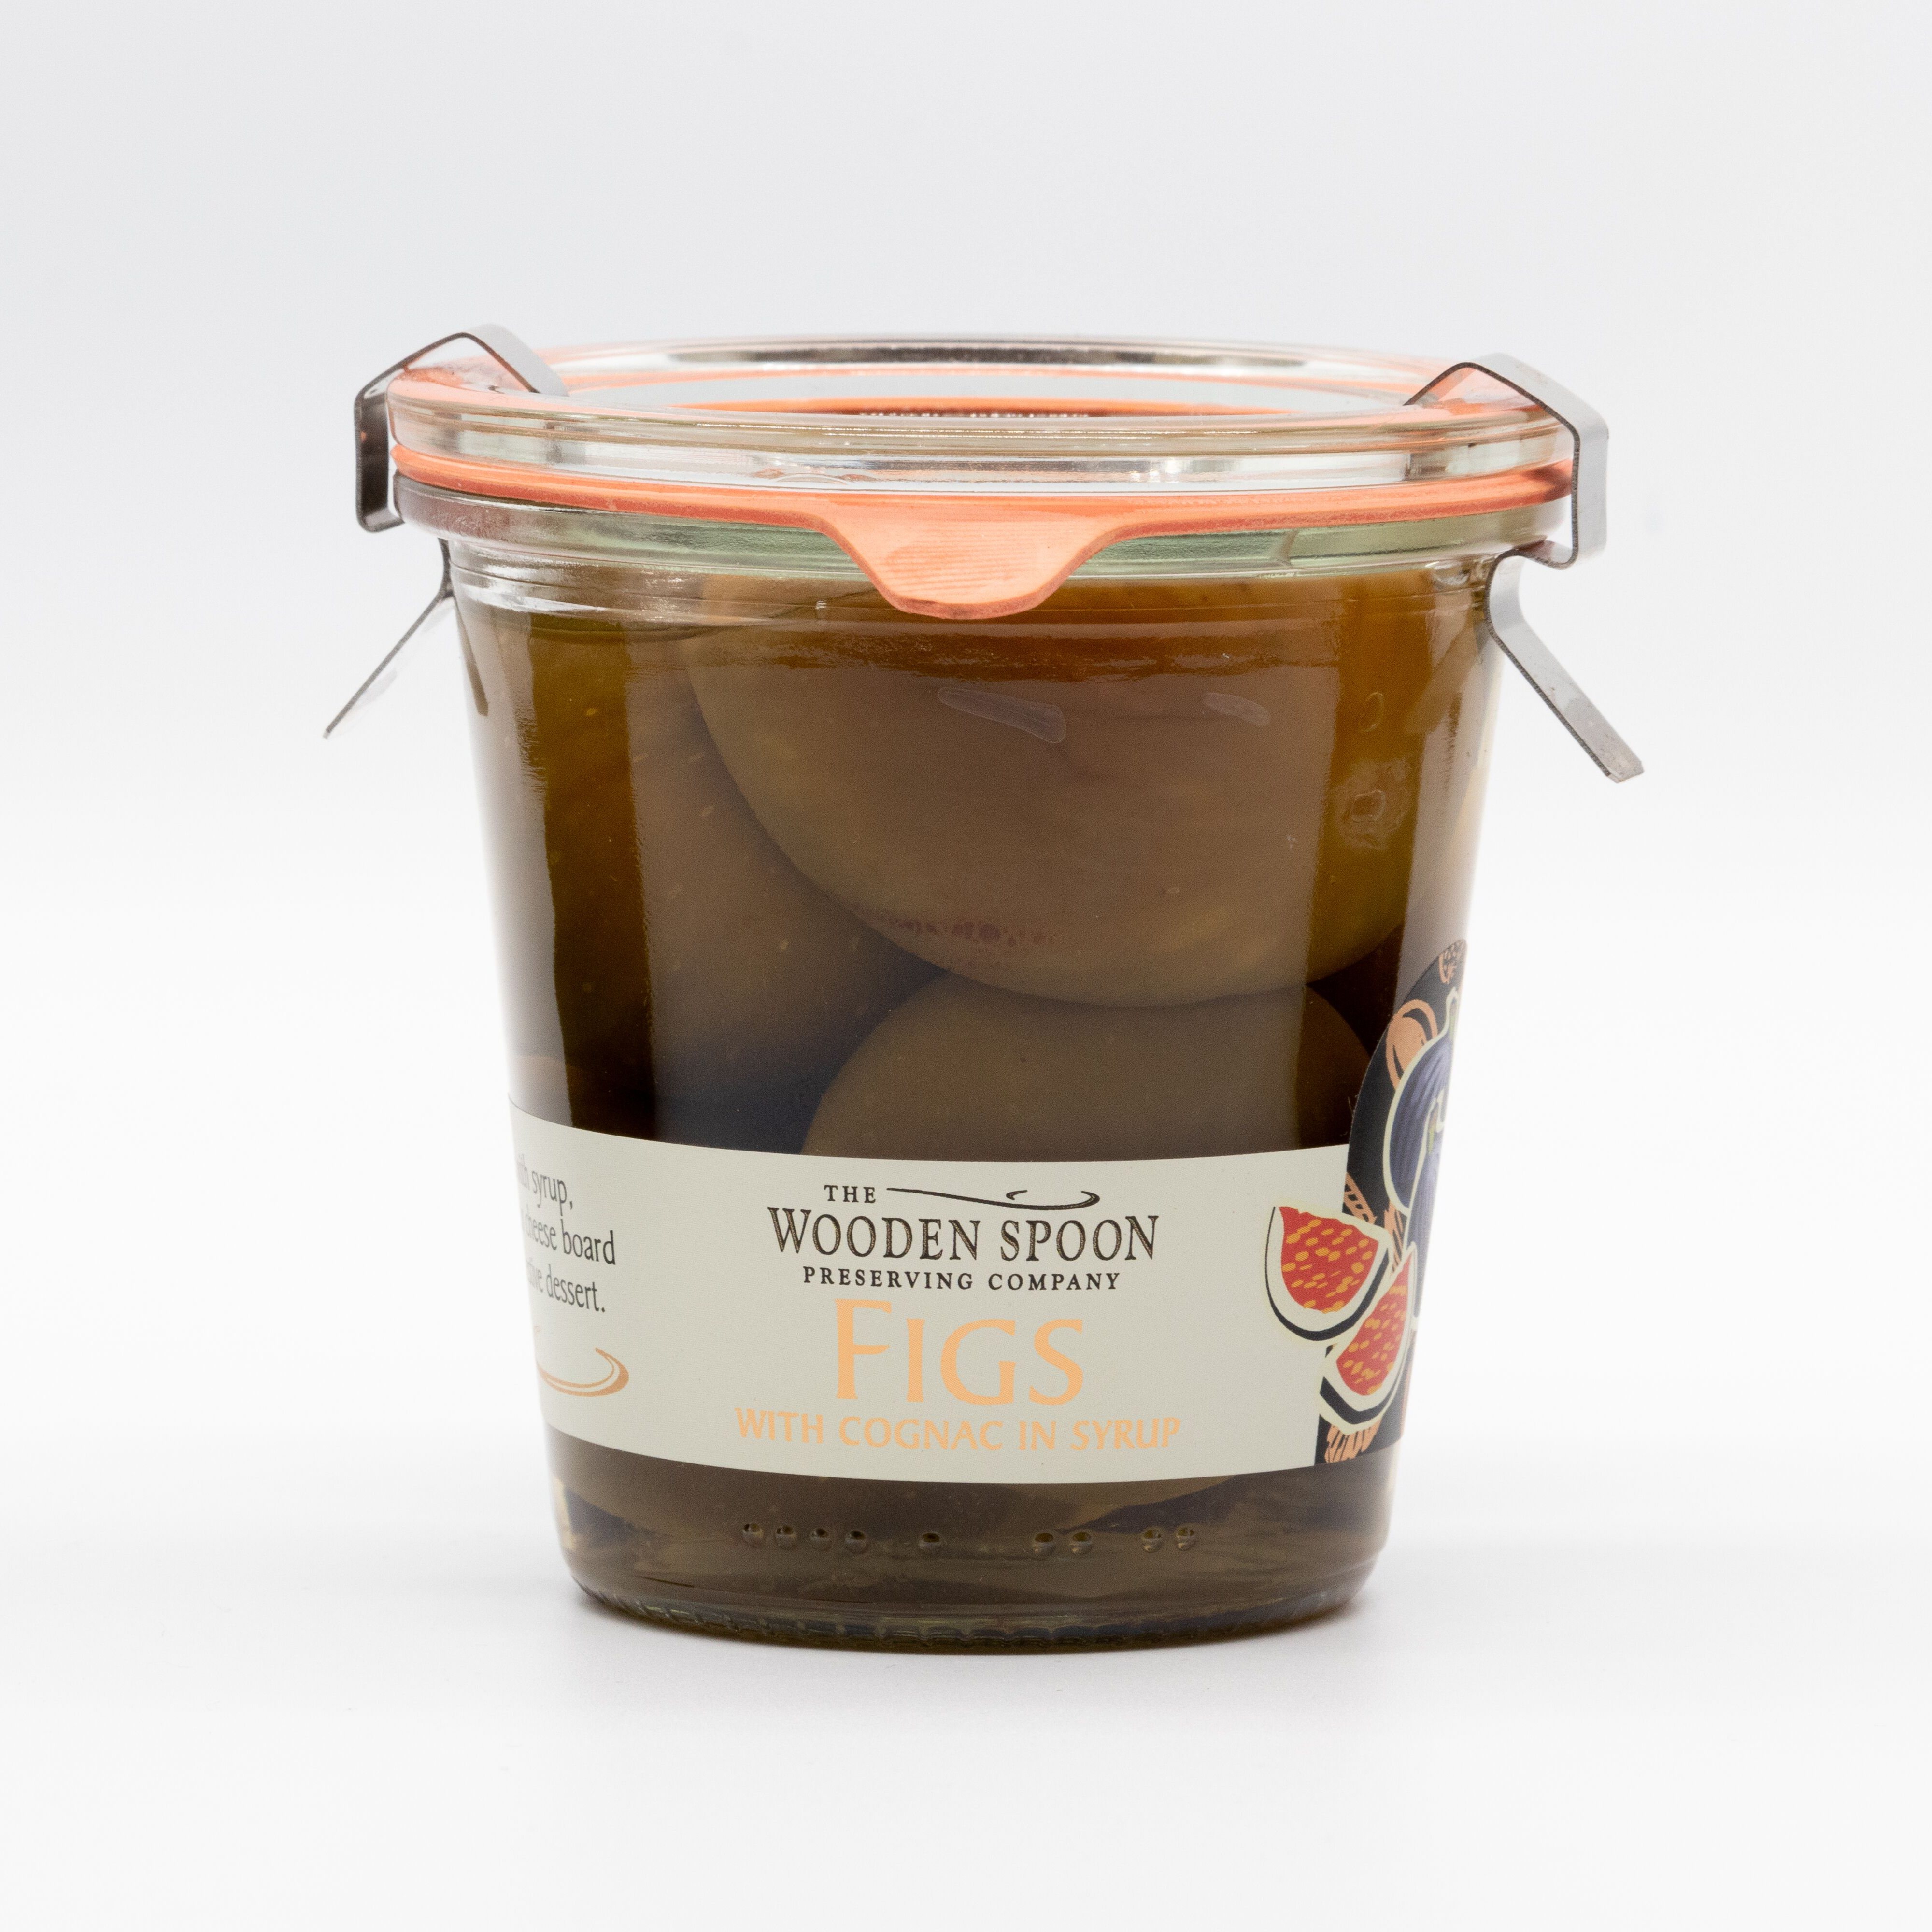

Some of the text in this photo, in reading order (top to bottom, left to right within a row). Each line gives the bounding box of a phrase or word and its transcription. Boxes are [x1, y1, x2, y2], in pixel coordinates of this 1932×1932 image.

[532, 1170, 573, 1216] syrup,
[824, 1184, 876, 1204] THE
[525, 1203, 557, 1250] cheese
[560, 1218, 616, 1265] board
[767, 1206, 1159, 1262] WOODEN SPOON
[546, 1263, 606, 1313] dessert.
[803, 1266, 1120, 1291] PRESERVING COMPANY
[835, 1298, 1083, 1406] FIGS
[735, 1407, 1181, 1450] WITH COGNAC IN SYRUP
